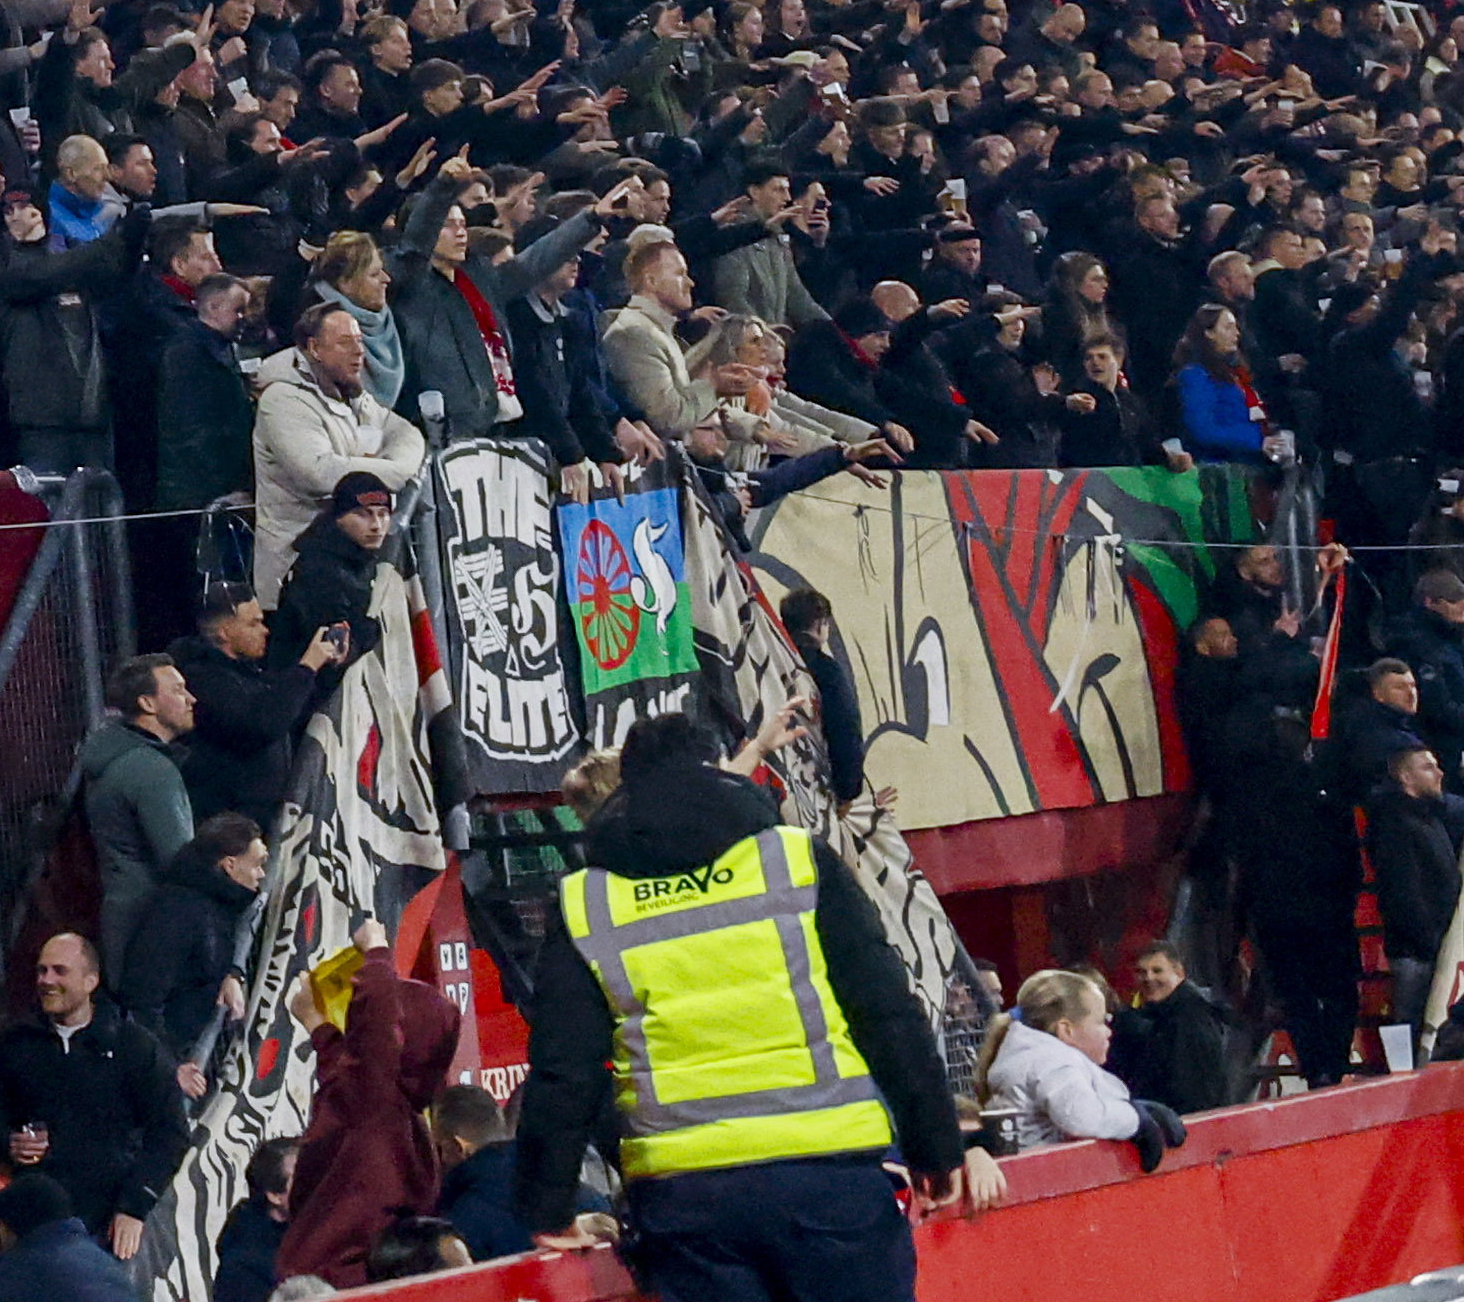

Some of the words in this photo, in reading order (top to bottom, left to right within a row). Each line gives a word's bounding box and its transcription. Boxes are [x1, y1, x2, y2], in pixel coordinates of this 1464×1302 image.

[445, 449, 552, 551] THE
[468, 657, 570, 748] ELITE
[633, 863, 734, 902] BRAVO
